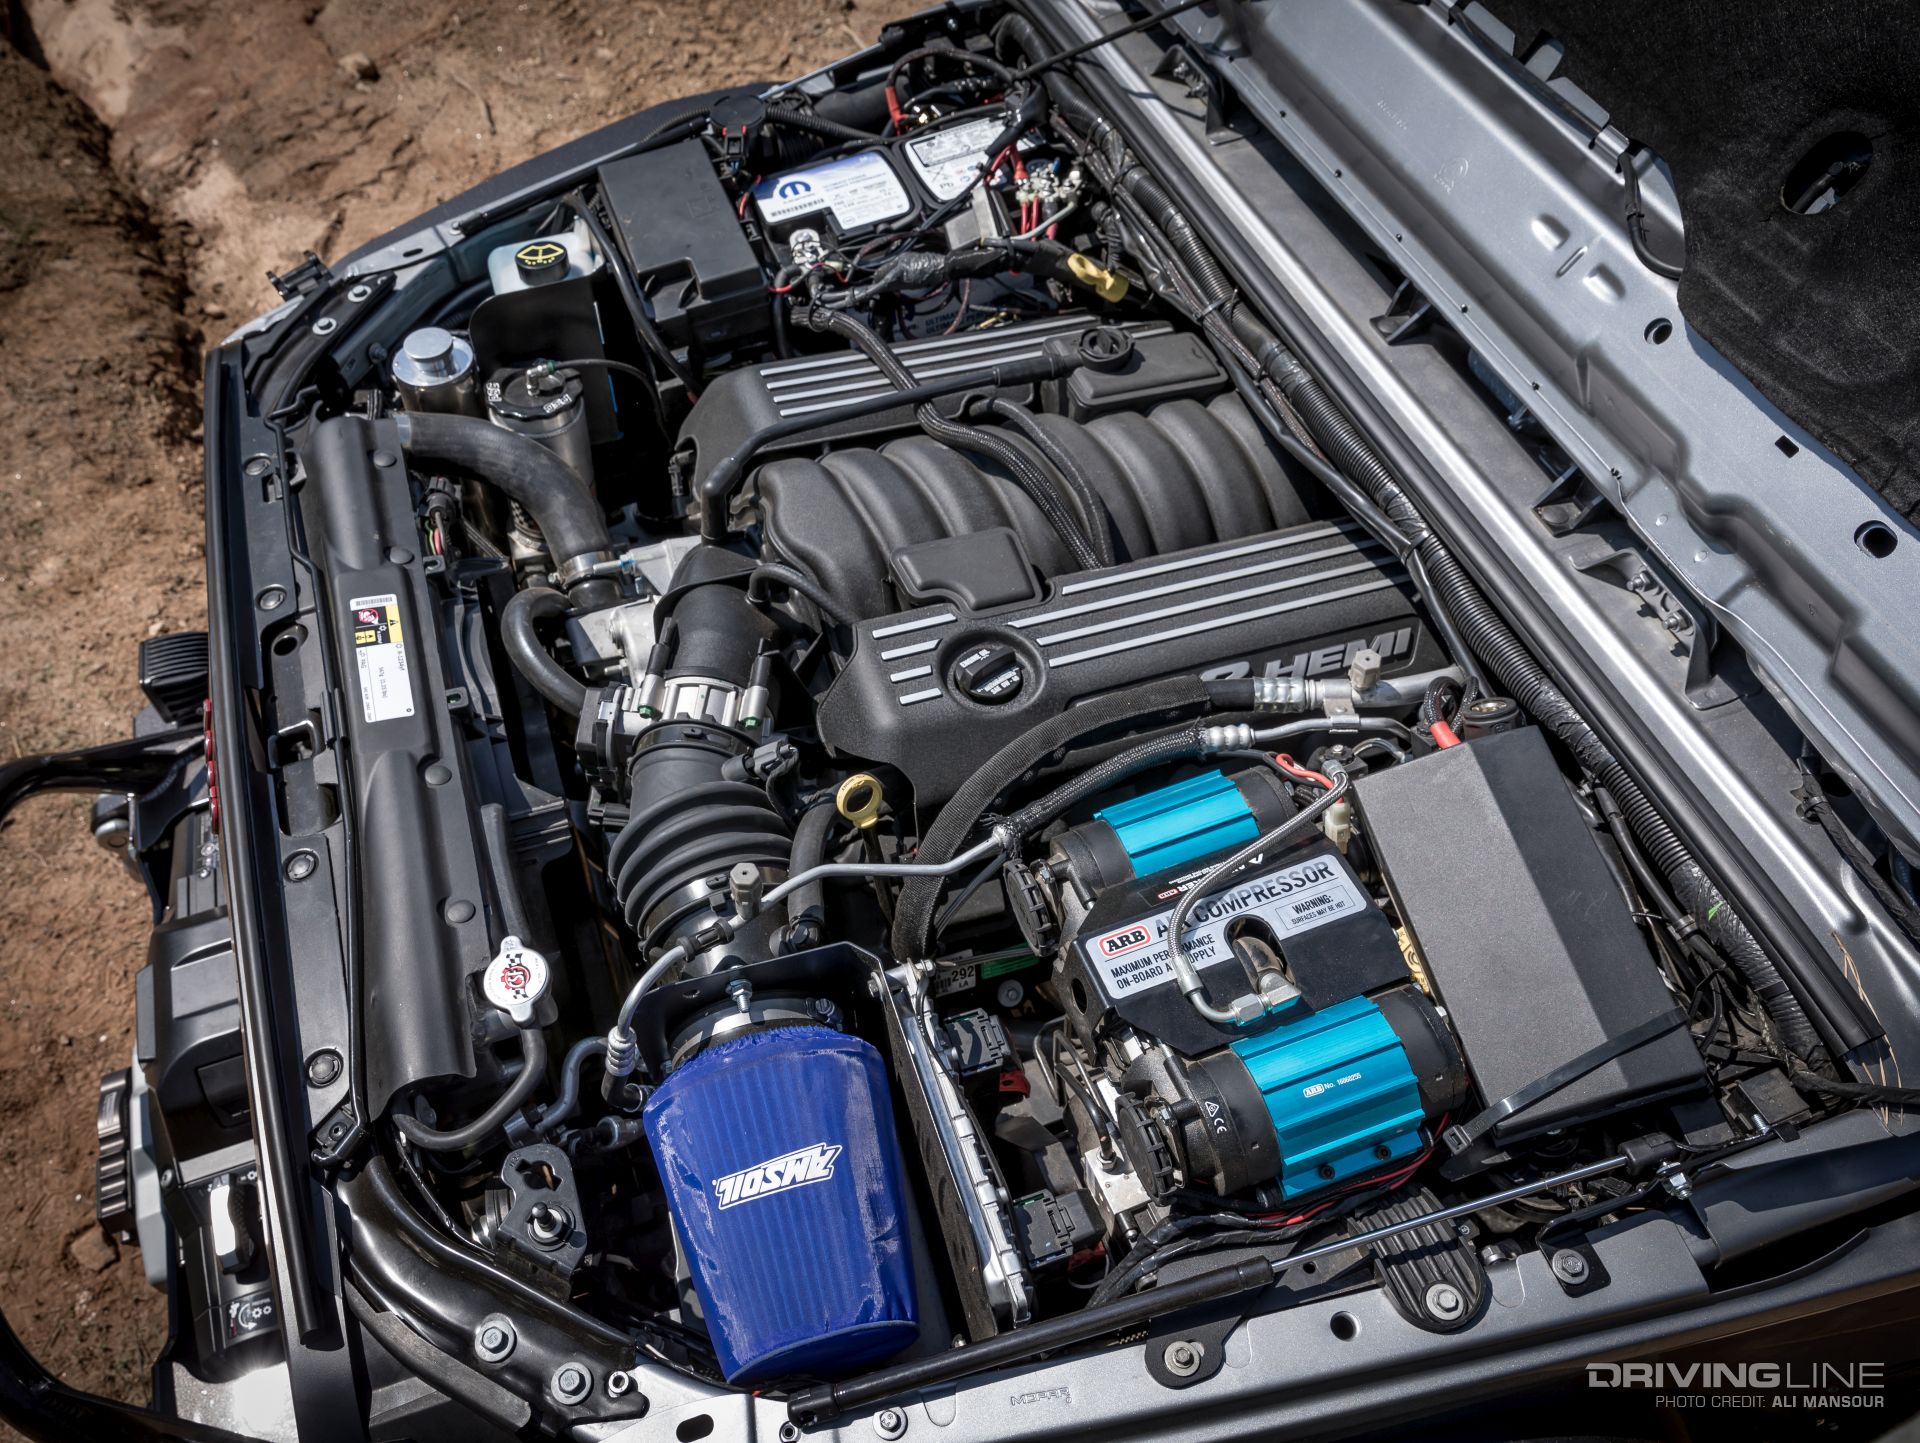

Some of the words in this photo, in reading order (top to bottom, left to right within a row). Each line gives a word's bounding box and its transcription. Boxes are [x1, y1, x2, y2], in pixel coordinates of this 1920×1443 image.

[1264, 627, 1412, 678] HEMI
[1197, 861, 1335, 923] COMPRESSOR
[1292, 894, 1333, 914] WARNING:
[1291, 912, 1317, 925] SURFACES
[1316, 907, 1328, 916] MAY
[1335, 900, 1346, 909] HOT
[1104, 929, 1147, 954] ARB
[1110, 956, 1153, 978] MAXIMUM
[1153, 933, 1216, 962] PERRMANCE
[951, 966, 975, 982] 292
[1116, 966, 1164, 989] ON-BOARD
[716, 1144, 839, 1207] AMSOIL
[1011, 1387, 1069, 1406] MOPAR
